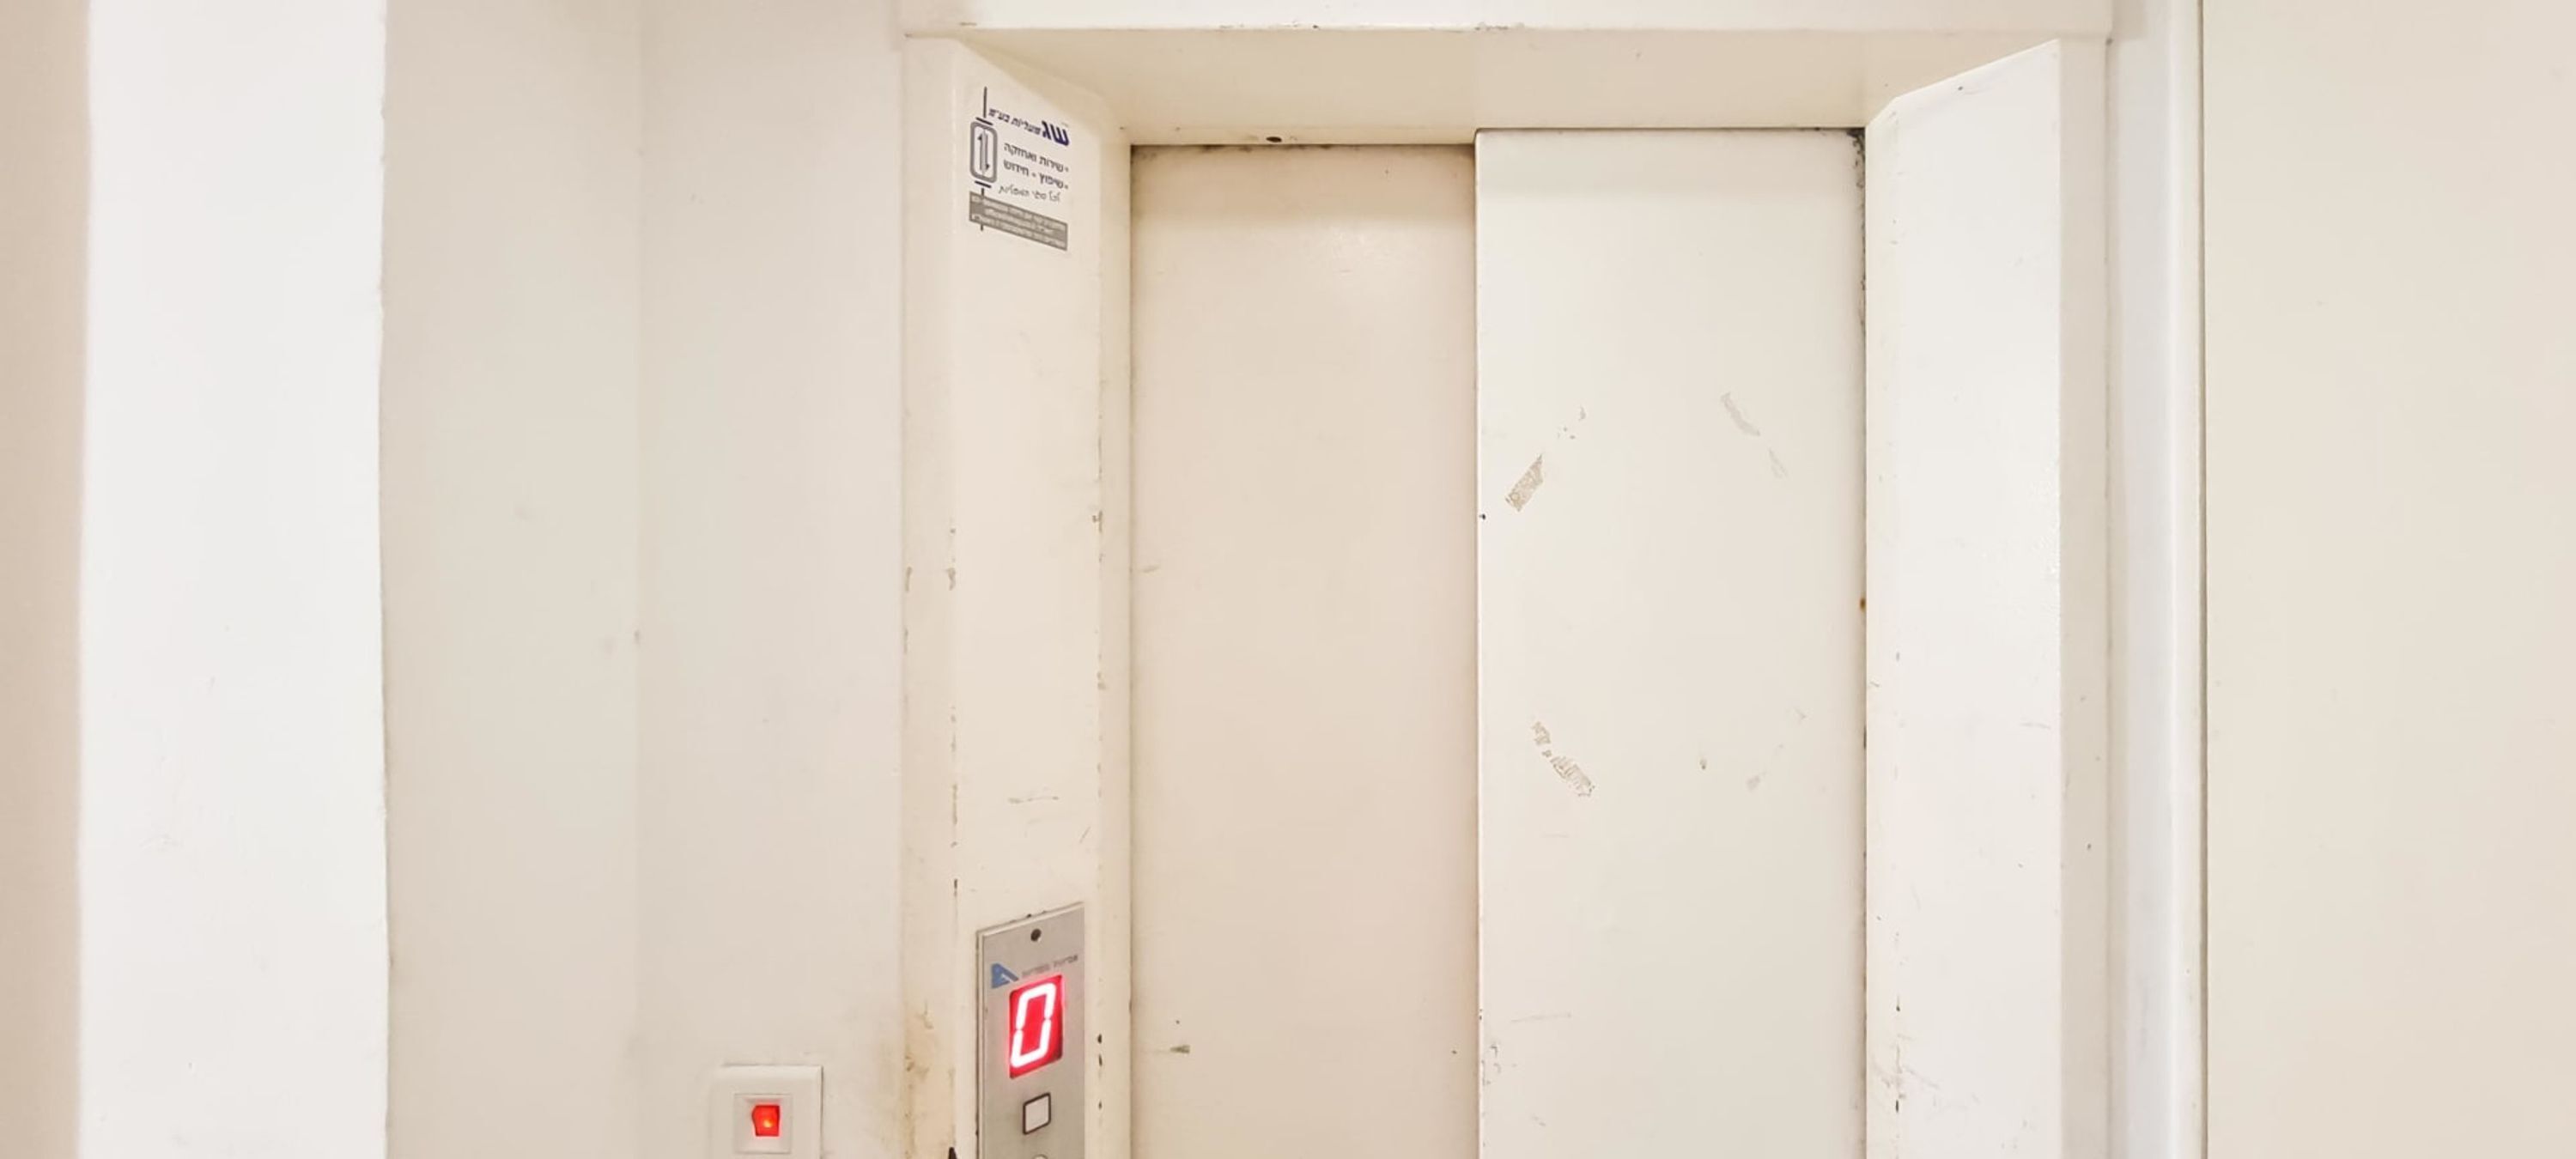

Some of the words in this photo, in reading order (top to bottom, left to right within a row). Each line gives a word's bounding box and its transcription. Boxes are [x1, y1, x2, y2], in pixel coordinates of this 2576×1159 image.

[1012, 117, 1042, 135] מעליות
[1042, 120, 1070, 147] שג
[1003, 142, 1037, 161] ואחזקה
[1003, 160, 1030, 176] חידוש
[1039, 156, 1064, 173] שירות
[1039, 172, 1064, 189] שיפוץ
[1010, 982, 1056, 1068] 0
